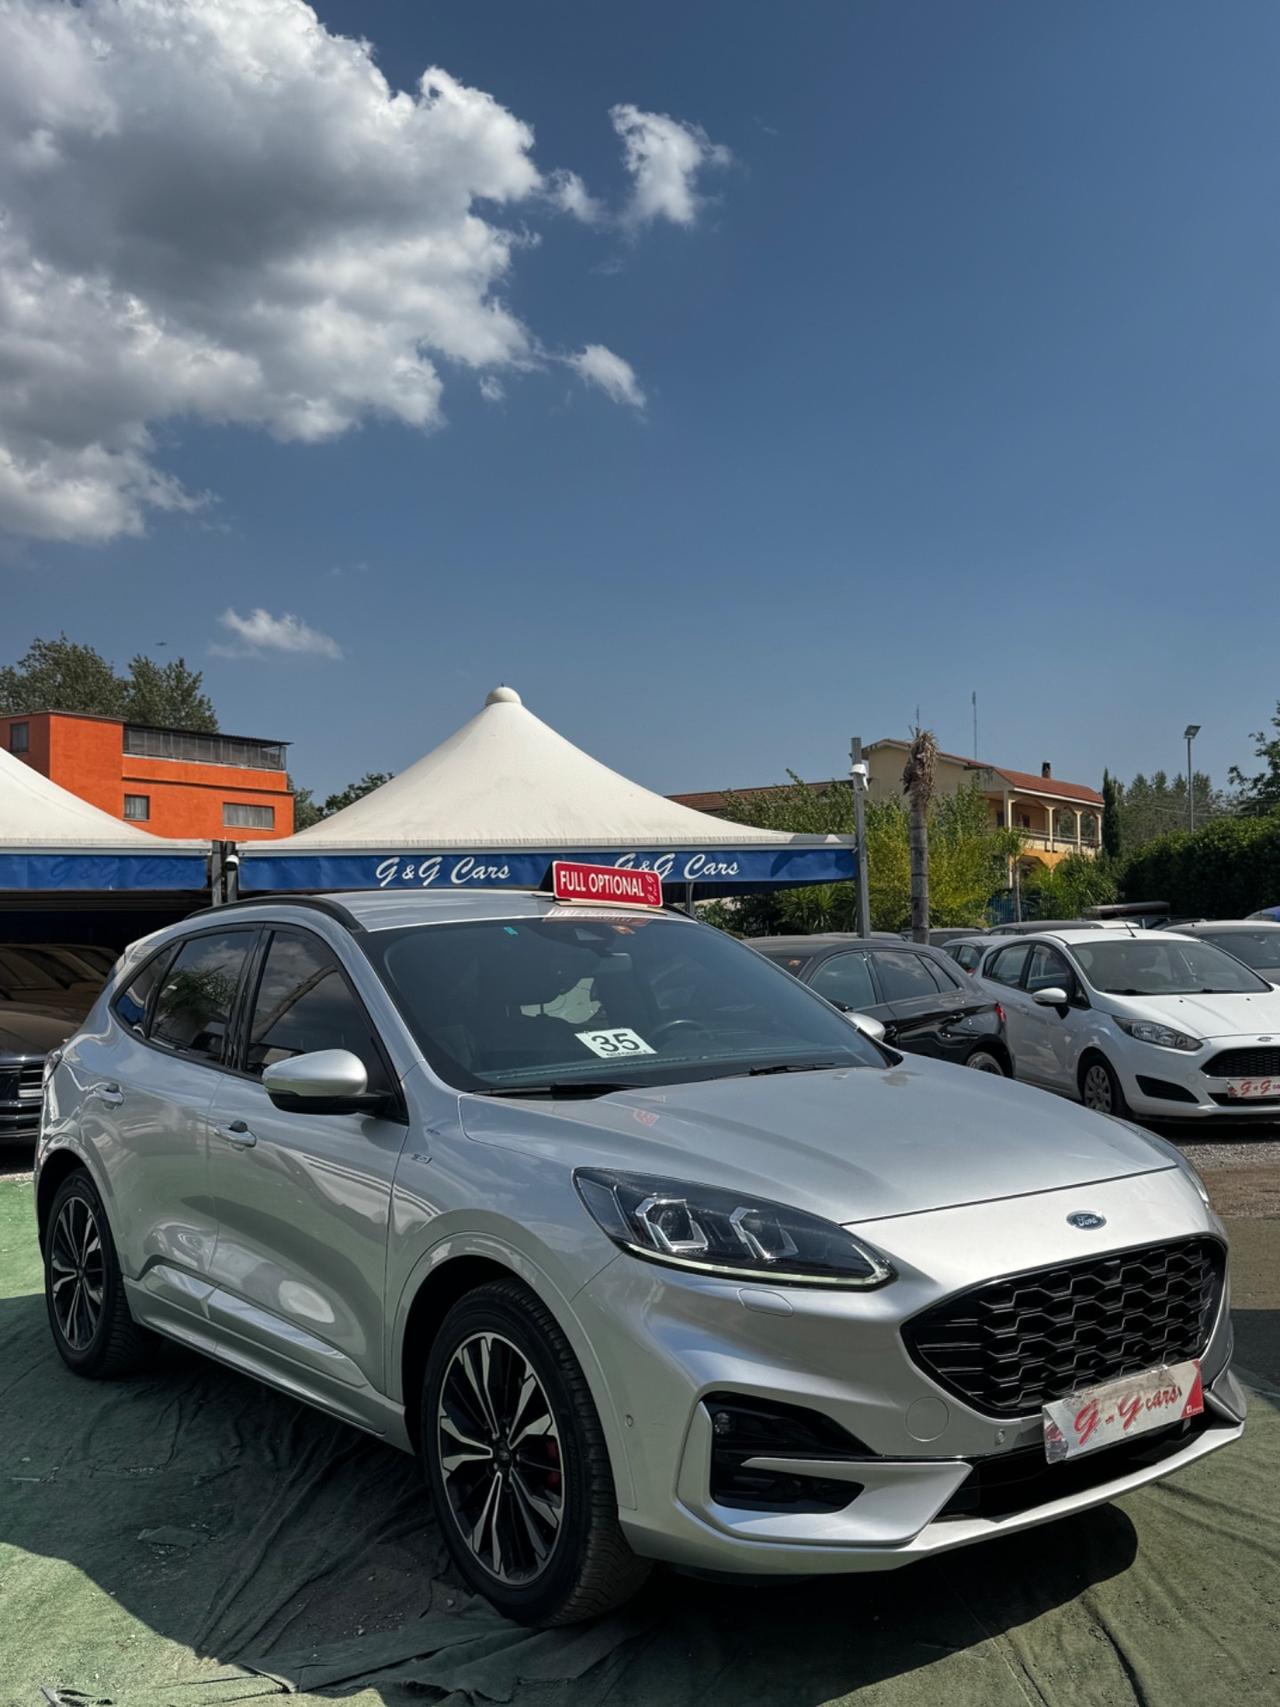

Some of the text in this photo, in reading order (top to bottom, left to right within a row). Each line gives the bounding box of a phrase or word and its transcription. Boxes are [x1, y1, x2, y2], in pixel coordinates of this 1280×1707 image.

[450, 856, 511, 884] Cars
[683, 853, 740, 880] Cars
[560, 870, 586, 892] FULL
[588, 872, 645, 897] OPTIONAL
[591, 1033, 640, 1052] 35
